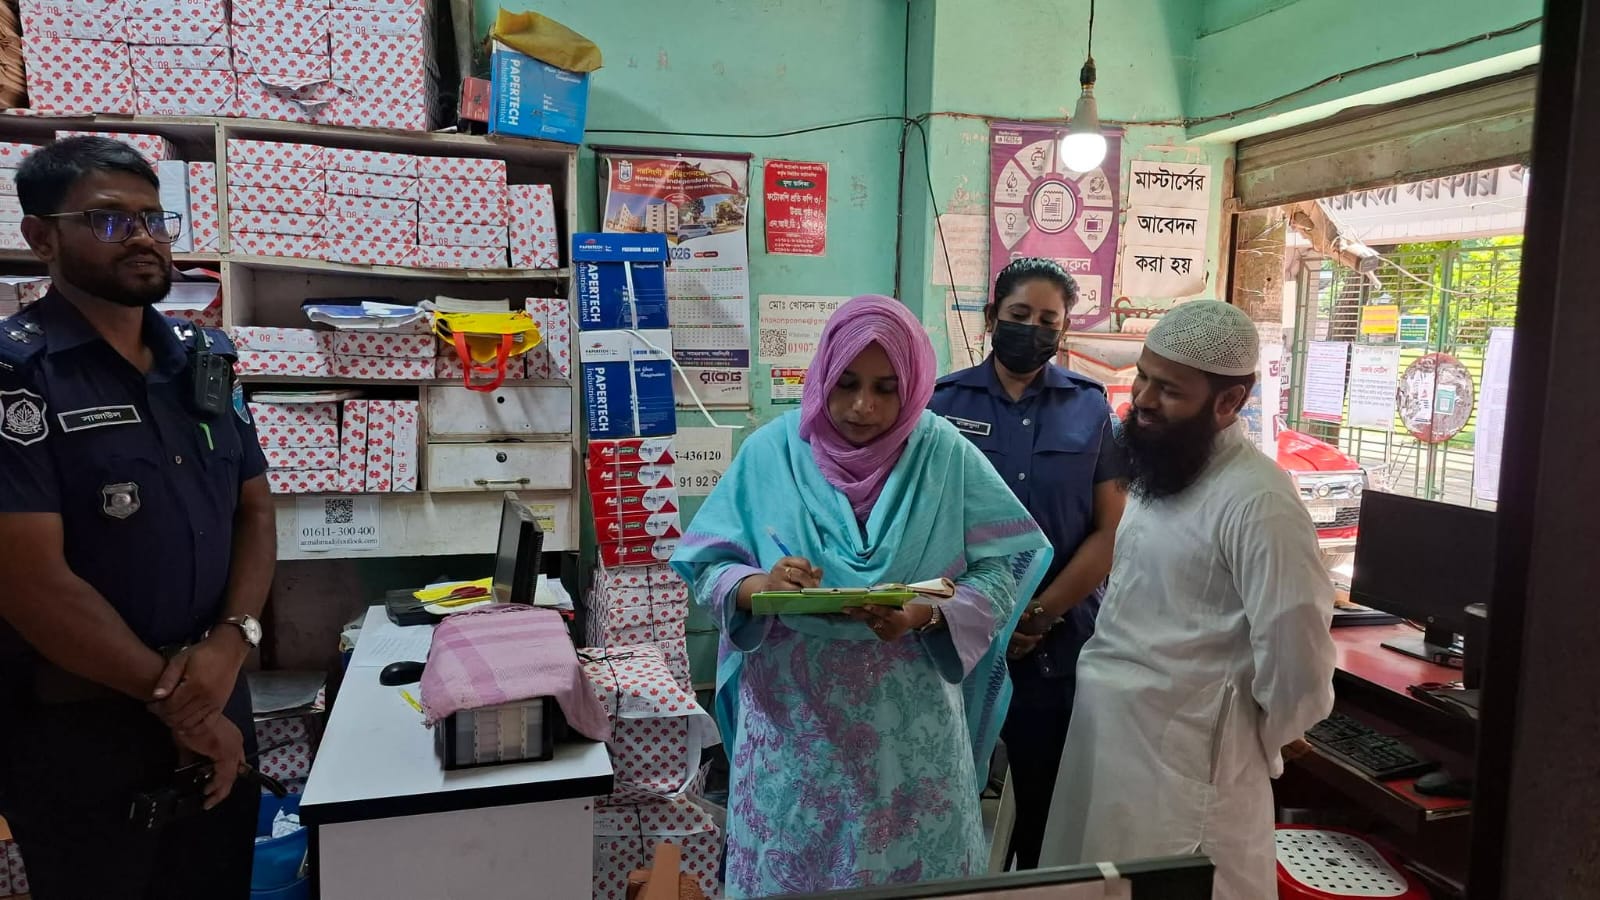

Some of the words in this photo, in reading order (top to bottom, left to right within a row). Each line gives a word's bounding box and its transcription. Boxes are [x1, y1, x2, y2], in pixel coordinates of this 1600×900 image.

[508, 59, 521, 126] PAPERTECH
[1134, 168, 1206, 192] মাস্টার্সের
[1137, 213, 1197, 236] আবেদন
[668, 247, 691, 260] 026
[1134, 255, 1163, 275] করা
[1170, 255, 1192, 275] হয়
[588, 261, 601, 322] APERTECH
[789, 300, 815, 310] খোকন
[595, 367, 609, 432] PAPERTECH
[680, 476, 692, 488] 91
[695, 475, 709, 487] 92
[711, 475, 722, 487] 9
[302, 527, 337, 537] 01611-
[339, 526, 356, 536] 300
[357, 526, 376, 536] 400
